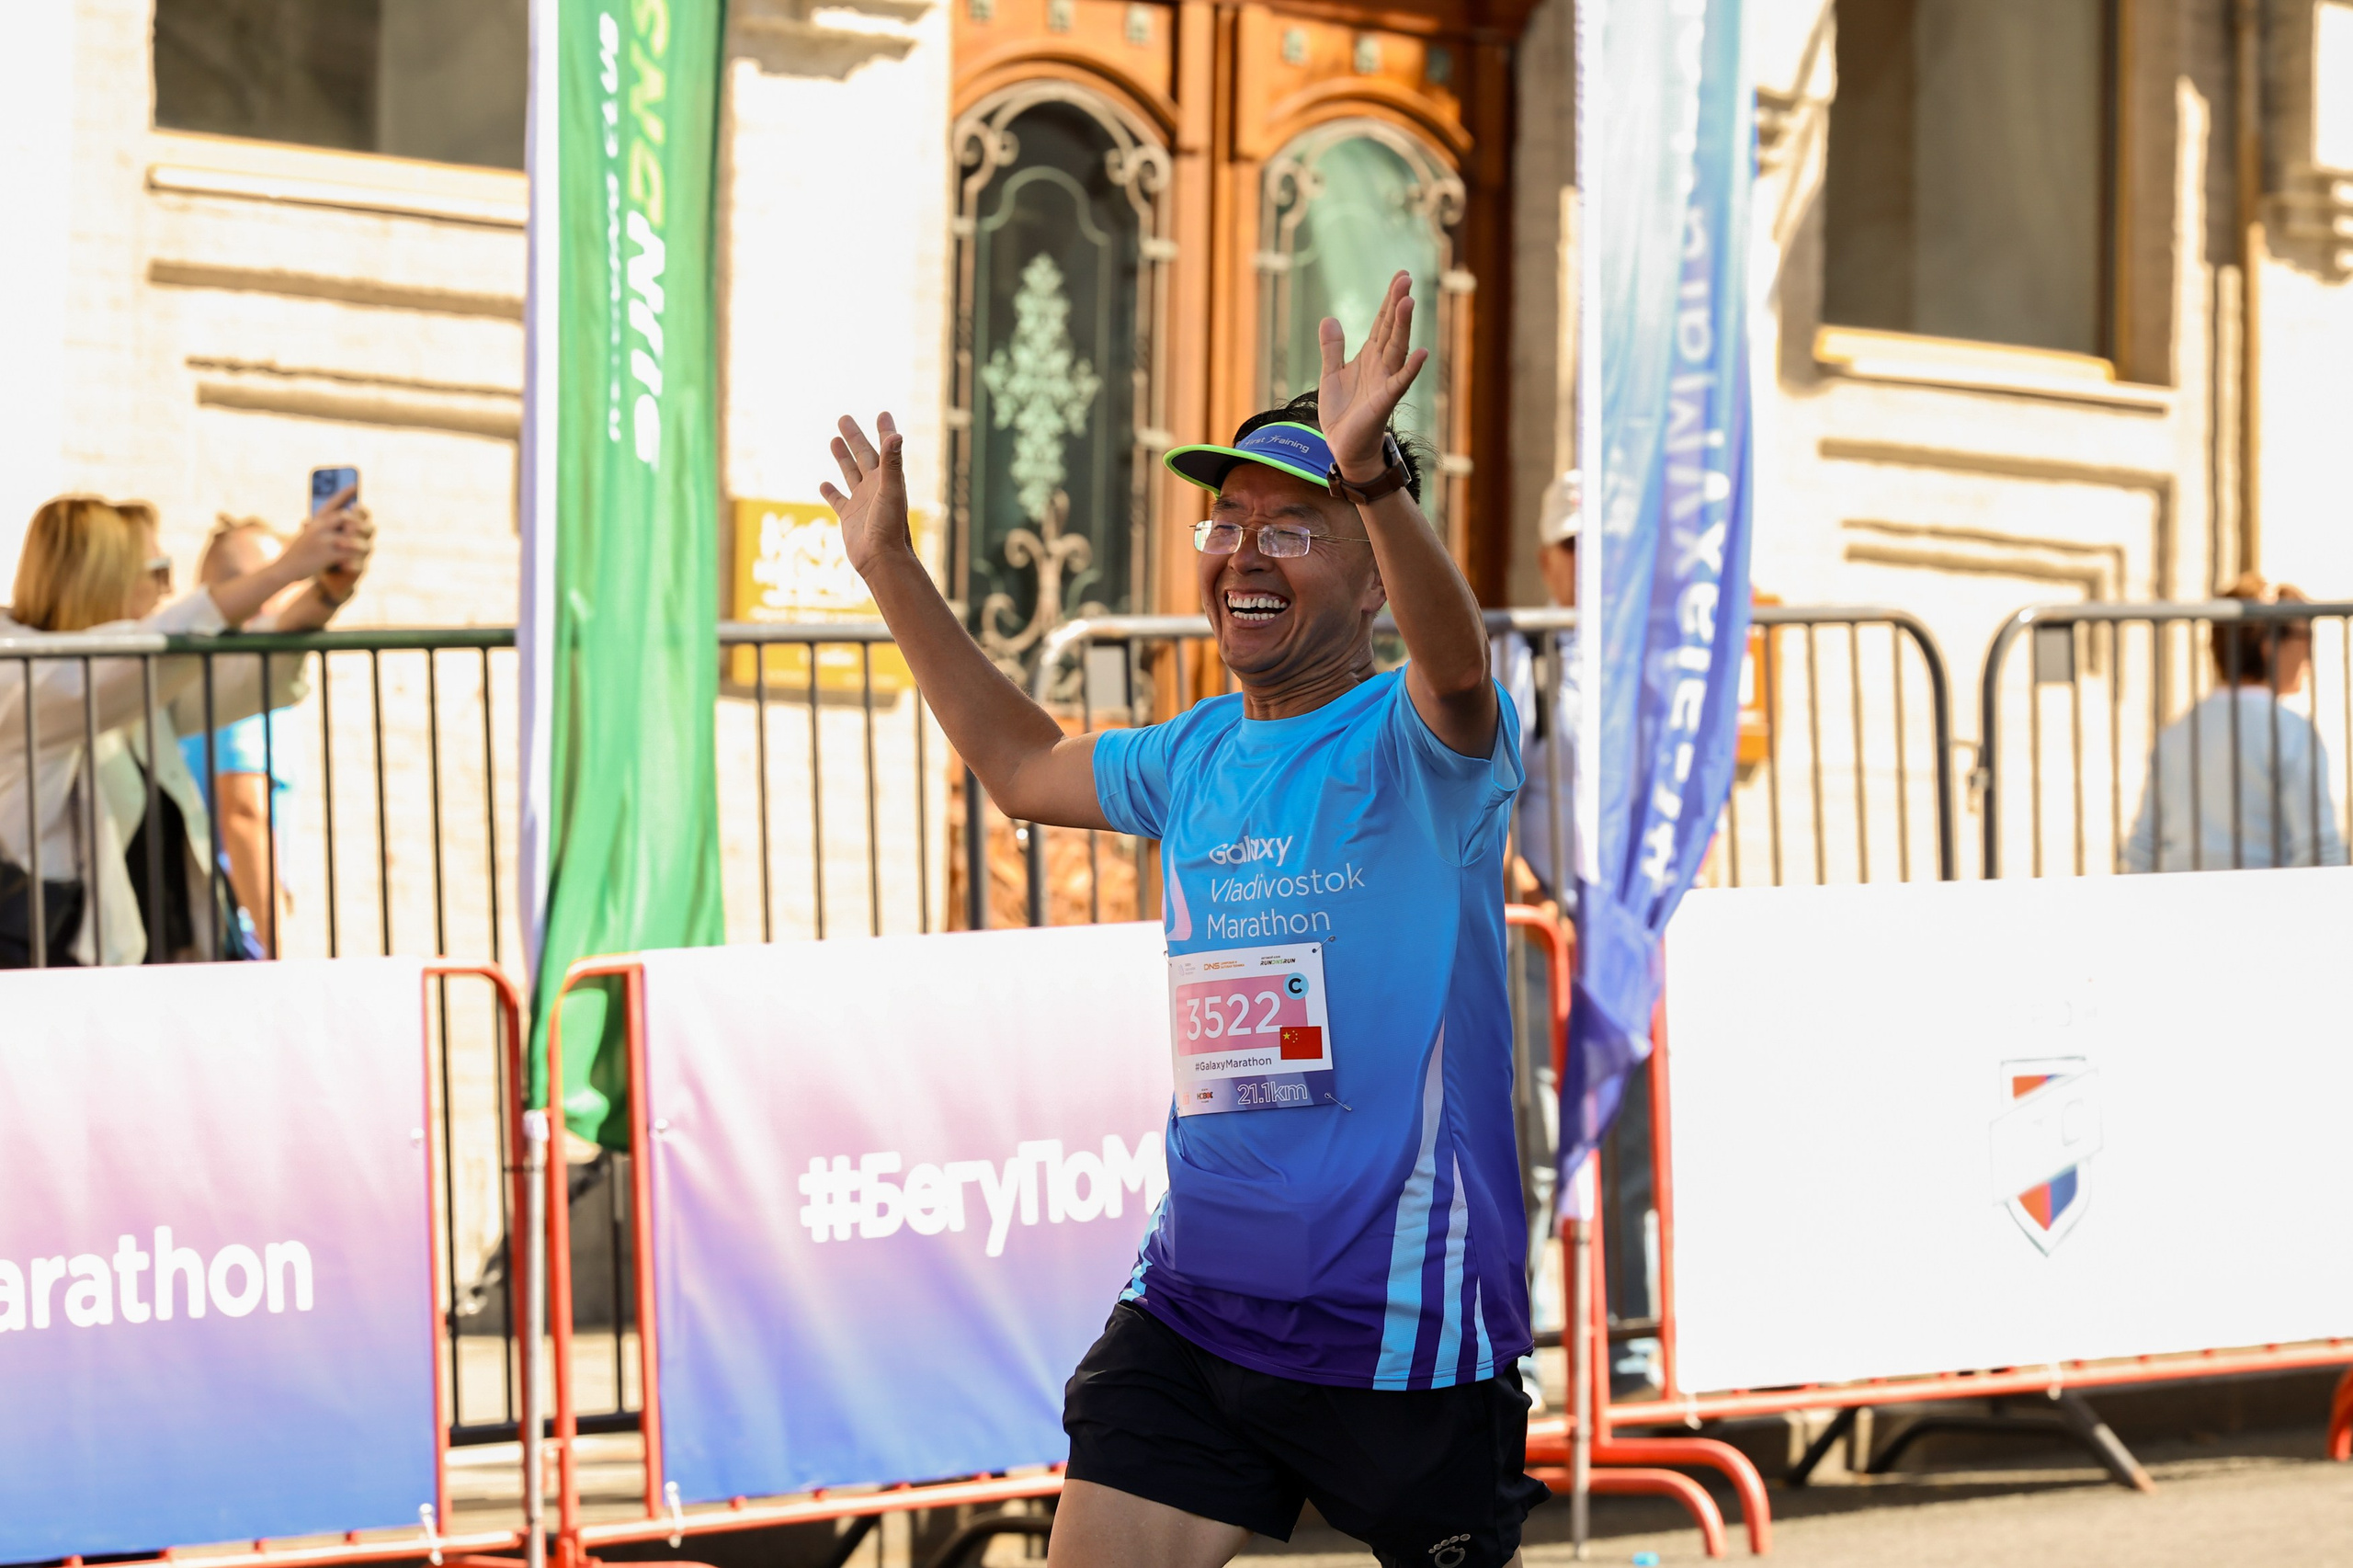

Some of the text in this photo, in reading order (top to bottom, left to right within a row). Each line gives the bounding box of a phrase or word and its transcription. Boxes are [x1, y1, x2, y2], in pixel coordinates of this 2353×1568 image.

[1267, 434, 1310, 454] Training
[1211, 862, 1366, 903] Vladivostok
[1208, 908, 1331, 939] Marathon
[1203, 962, 1220, 971] DNS
[1288, 977, 1302, 994] C
[1186, 990, 1283, 1041] 3522
[1195, 1056, 1272, 1072] #GalaxyMarathon
[1237, 1081, 1308, 1105] 21.1km
[799, 1131, 1169, 1257] #БегуПоМ
